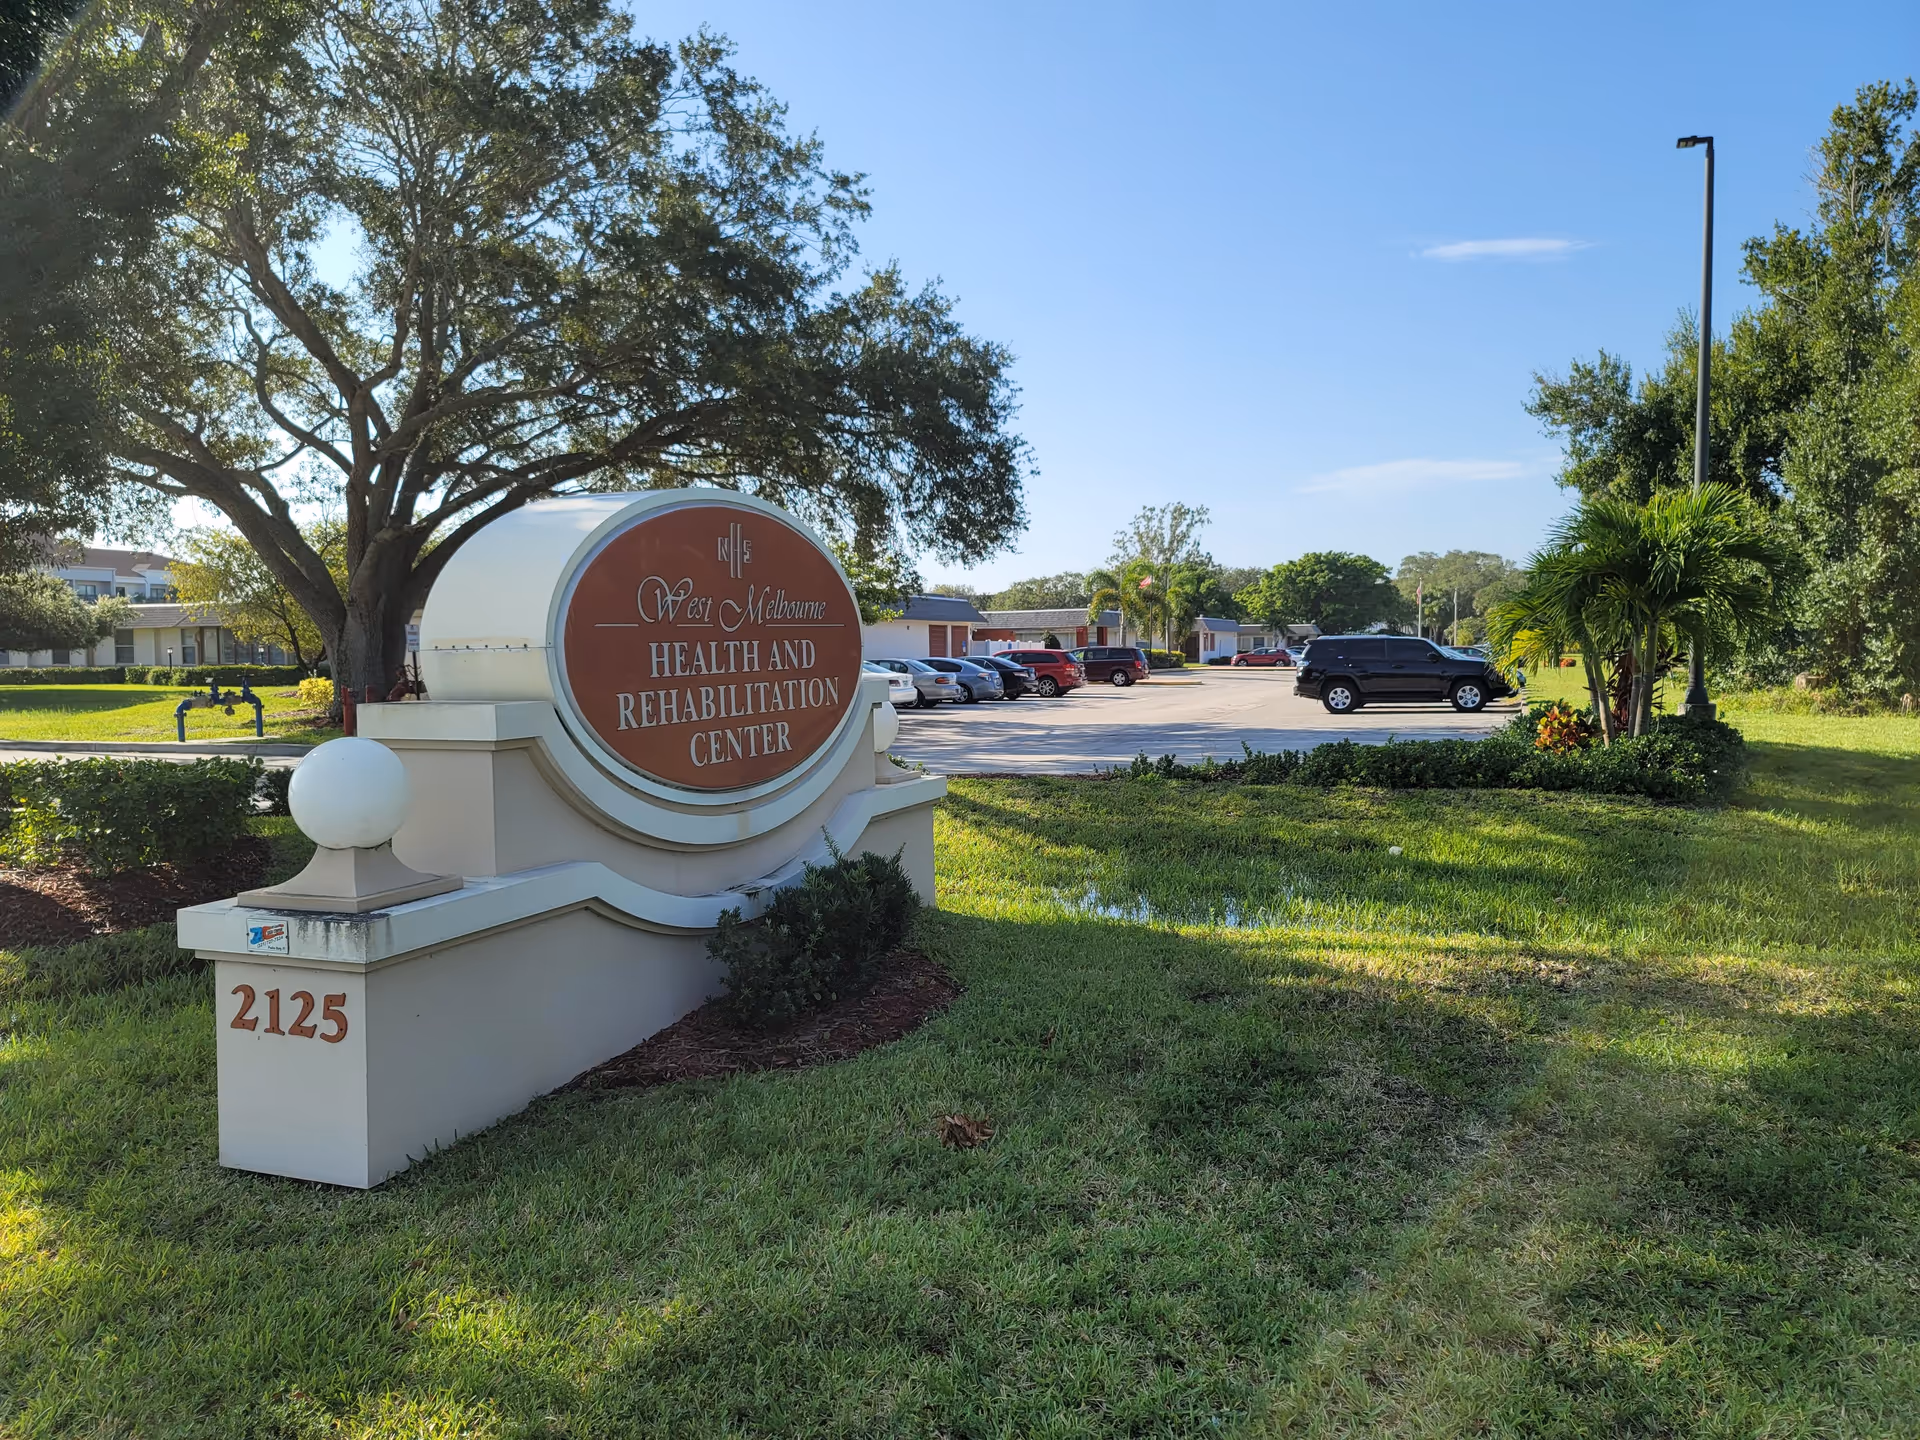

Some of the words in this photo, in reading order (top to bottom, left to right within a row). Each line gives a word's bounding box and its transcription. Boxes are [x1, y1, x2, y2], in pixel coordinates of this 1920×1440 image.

[636, 575, 714, 624] West
[718, 583, 827, 632] Melbourne
[648, 639, 761, 678] HEALTH
[767, 638, 816, 671] AND
[615, 676, 840, 731] REHABILITATION
[689, 721, 793, 767] CENTER
[230, 983, 348, 1043] 2125
